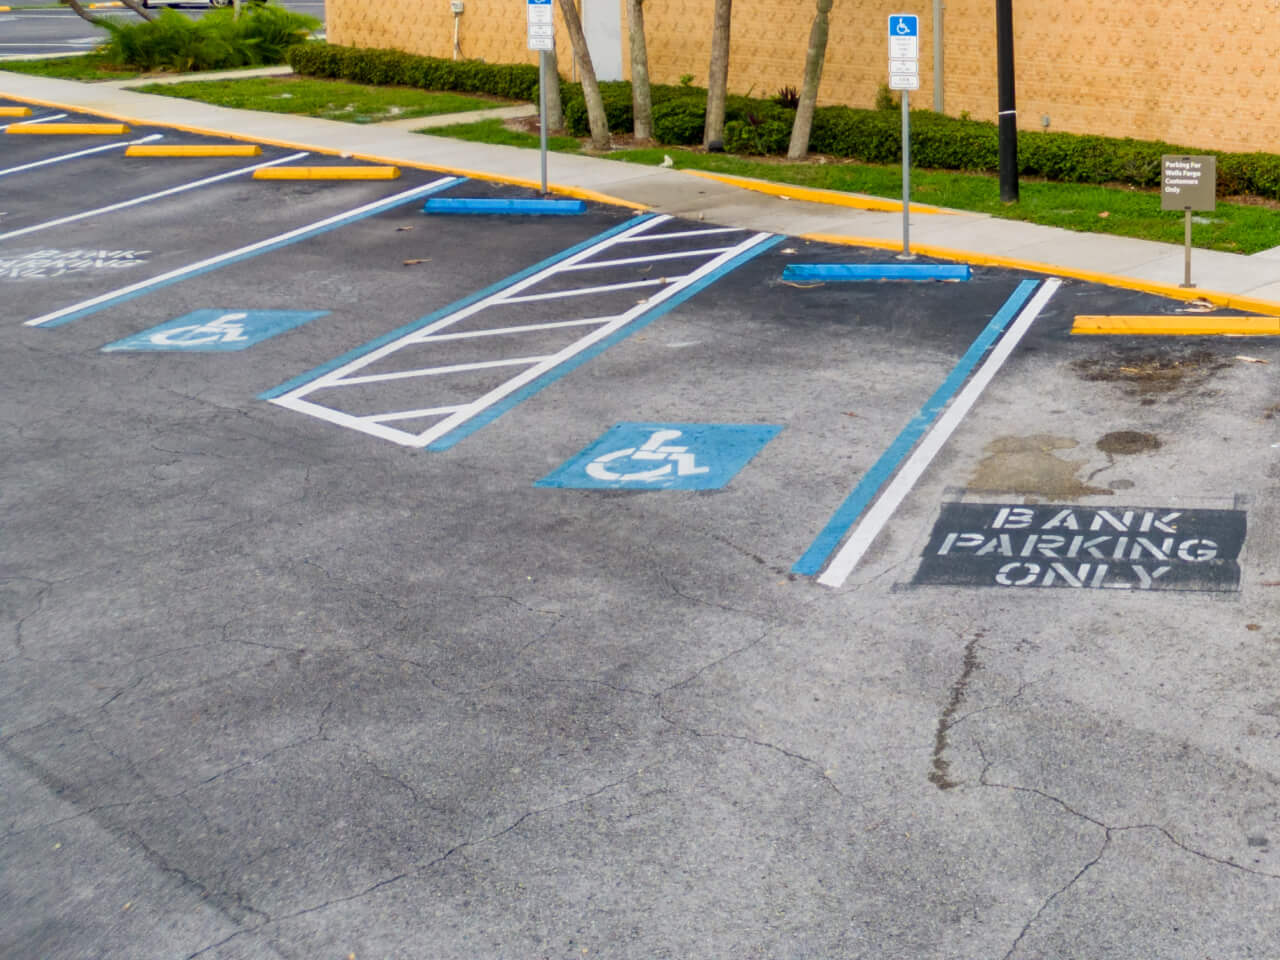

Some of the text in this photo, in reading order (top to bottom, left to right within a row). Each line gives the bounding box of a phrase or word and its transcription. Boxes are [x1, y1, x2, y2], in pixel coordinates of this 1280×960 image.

[1165, 161, 1202, 170] Parking For
[1183, 170, 1202, 178] Fargo
[1165, 177, 1198, 185] Customers
[1165, 186, 1180, 195] Only
[991, 507, 1183, 533] BANK
[937, 531, 1218, 562] PARKING
[994, 561, 1172, 589] ONLY
